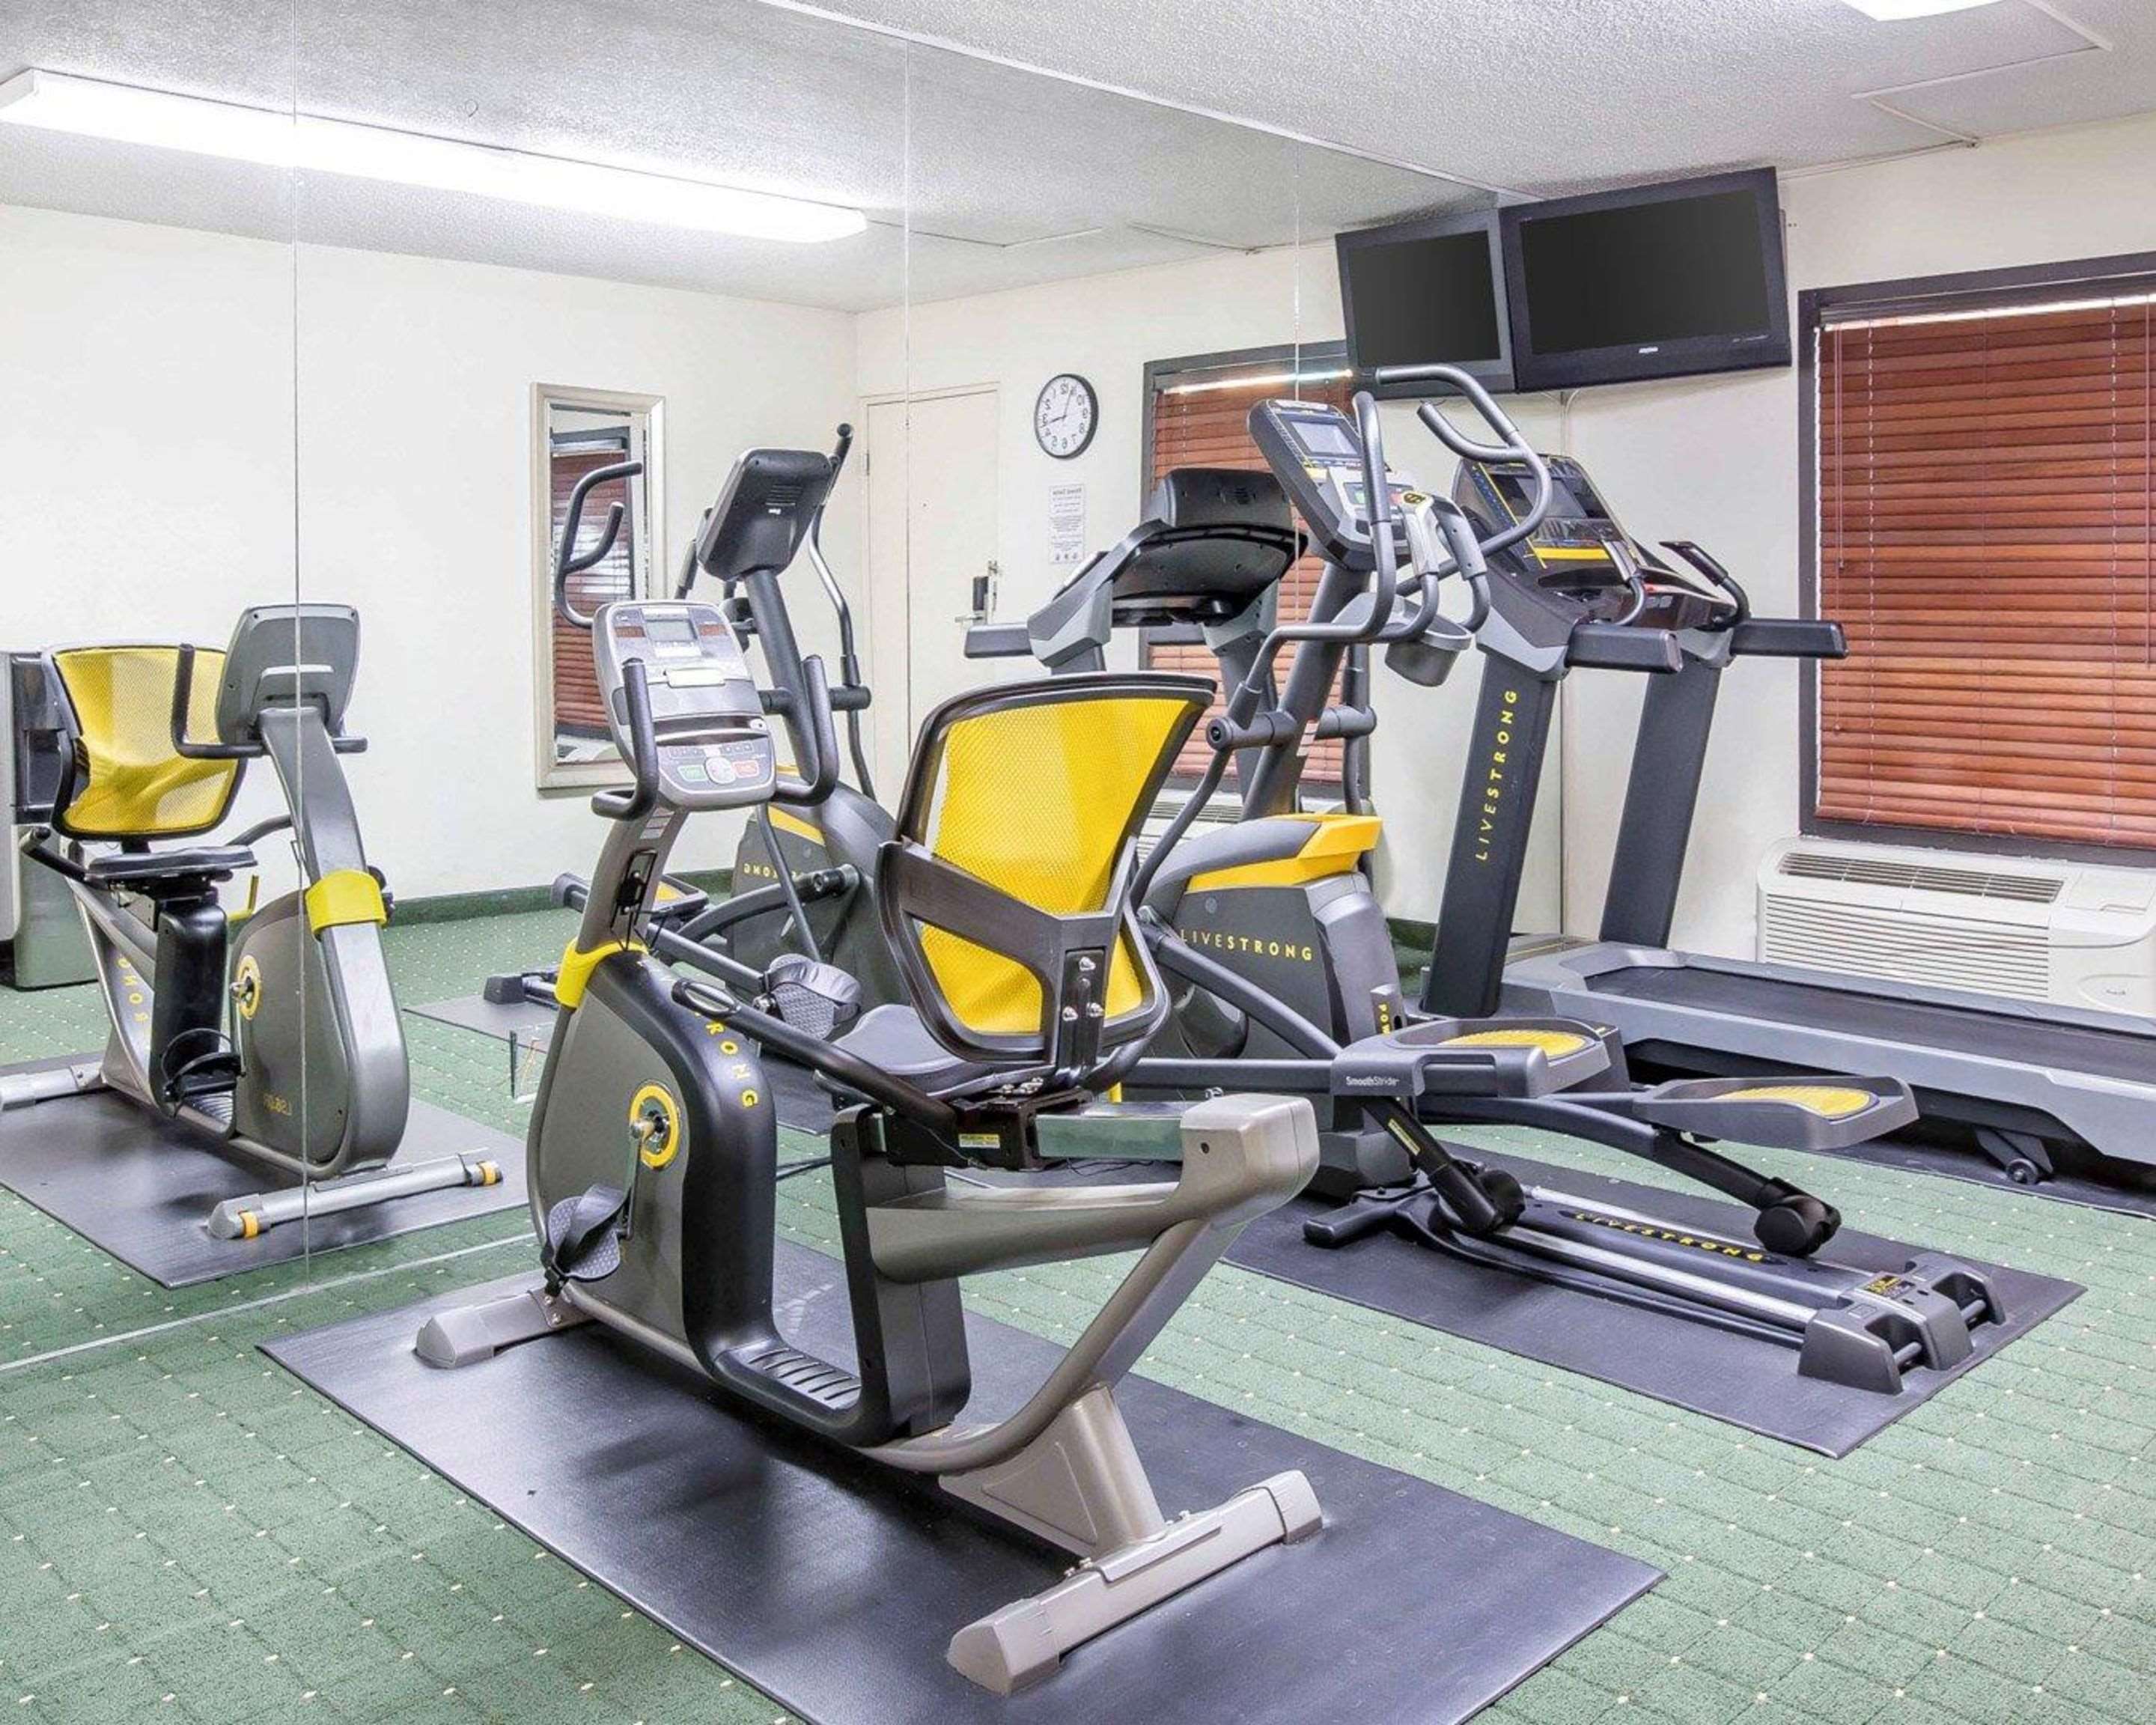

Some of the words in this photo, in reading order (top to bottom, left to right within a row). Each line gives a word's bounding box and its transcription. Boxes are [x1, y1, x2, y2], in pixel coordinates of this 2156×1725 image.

[1475, 690, 1517, 861] LIVESTRONG
[1181, 928, 1312, 961] LIVESTRONG
[695, 1012, 758, 1108] RONG
[1575, 1212, 1763, 1262] LIVESTRONG
